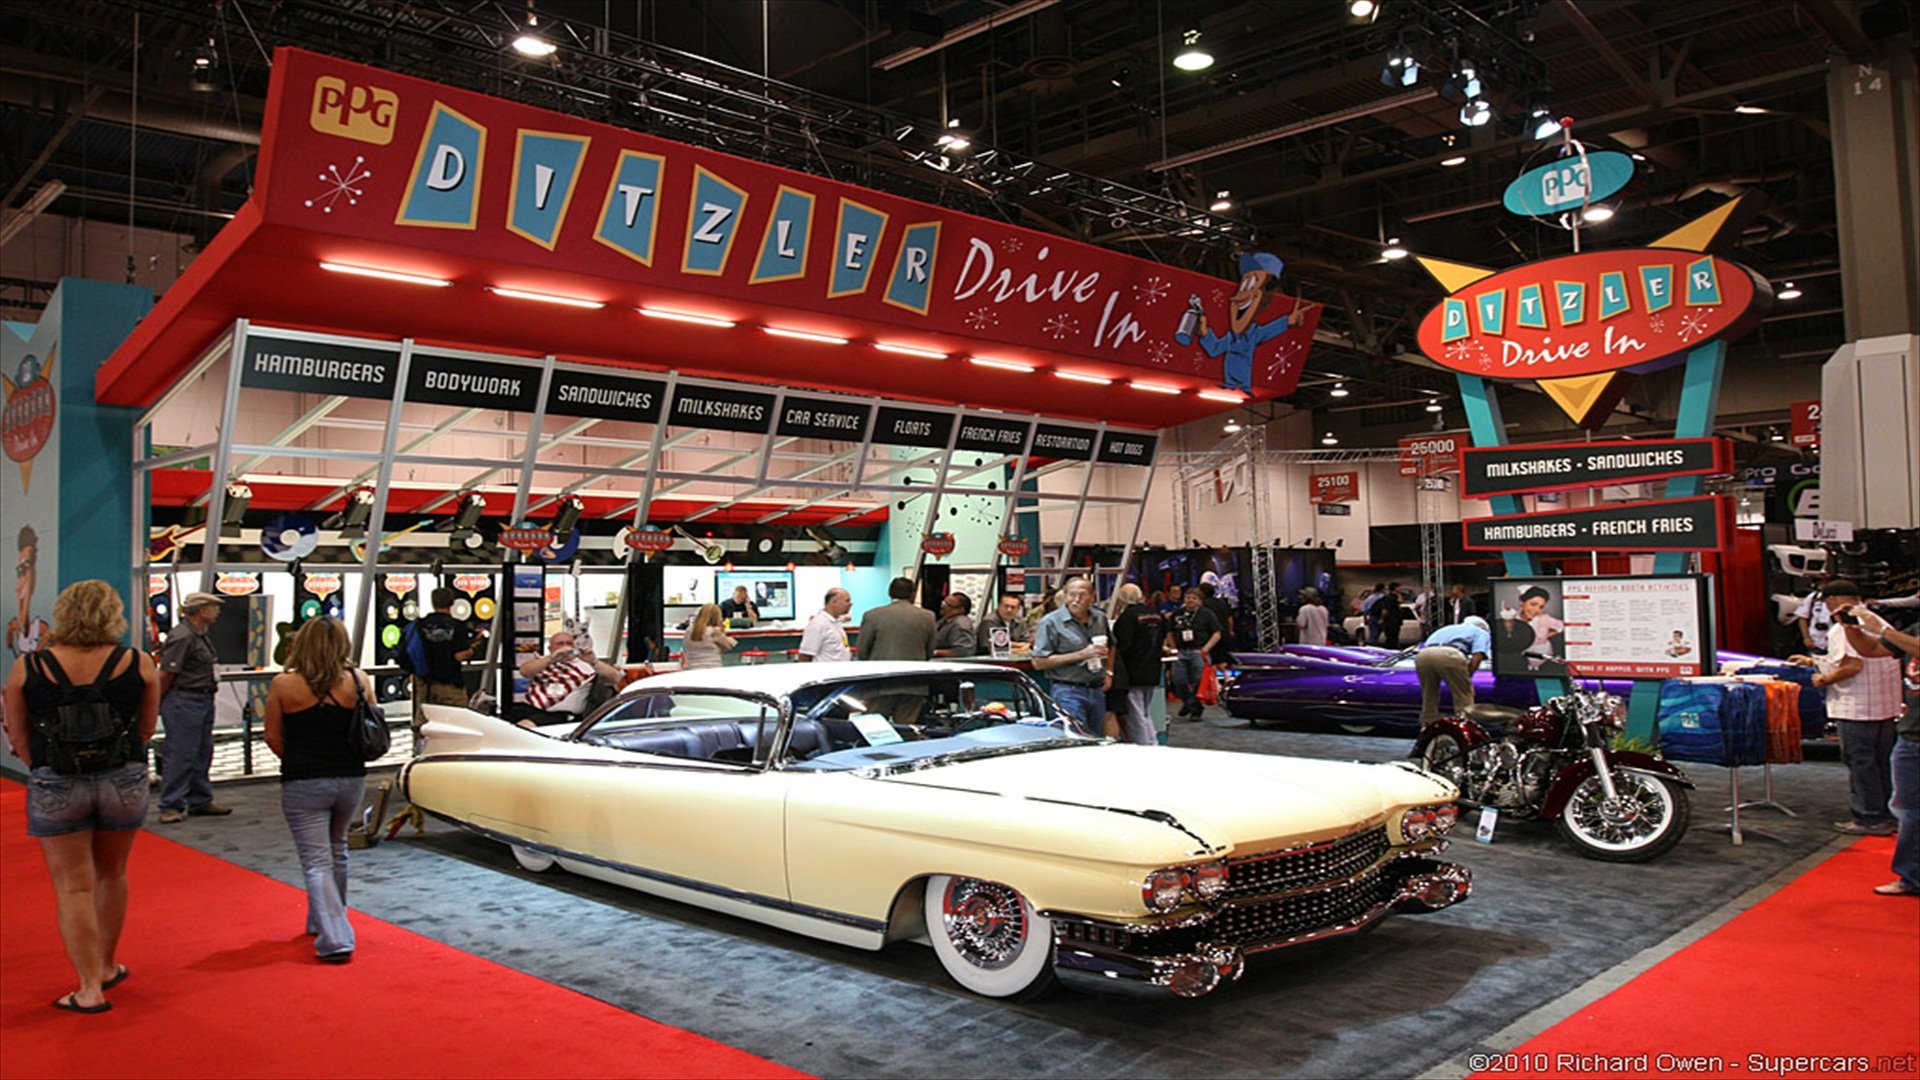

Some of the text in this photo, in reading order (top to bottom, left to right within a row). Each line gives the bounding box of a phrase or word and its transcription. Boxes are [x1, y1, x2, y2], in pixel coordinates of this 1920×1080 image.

[1853, 77, 1883, 96] 14
[318, 86, 393, 127] PPG
[425, 143, 929, 284] DITZLER
[953, 237, 1100, 303] Drive
[1449, 270, 1713, 328] DITZLER
[1093, 290, 1147, 349] In
[1501, 325, 1646, 368] Drive In
[254, 353, 386, 384] HAMBURGERS
[425, 370, 522, 397] BODYWORK
[558, 385, 652, 409] SANDWICHES
[677, 397, 764, 421] MILKSHAKES
[785, 409, 860, 430] CAR SERVICE
[893, 420, 932, 436] FLOATS
[961, 426, 1023, 445] FRENCH FRIES
[1034, 434, 1091, 451] RESTORATION
[1410, 439, 1455, 455] 25000
[1109, 442, 1144, 456] HOT DOGS
[1486, 458, 1573, 478] MILKSHAKES
[1587, 449, 1685, 471] SANDWICHES
[1317, 475, 1350, 488] 25100
[1484, 522, 1577, 540] HAMBURGERS
[1592, 519, 1648, 536] FRENCH
[1652, 517, 1694, 534] FRIES
